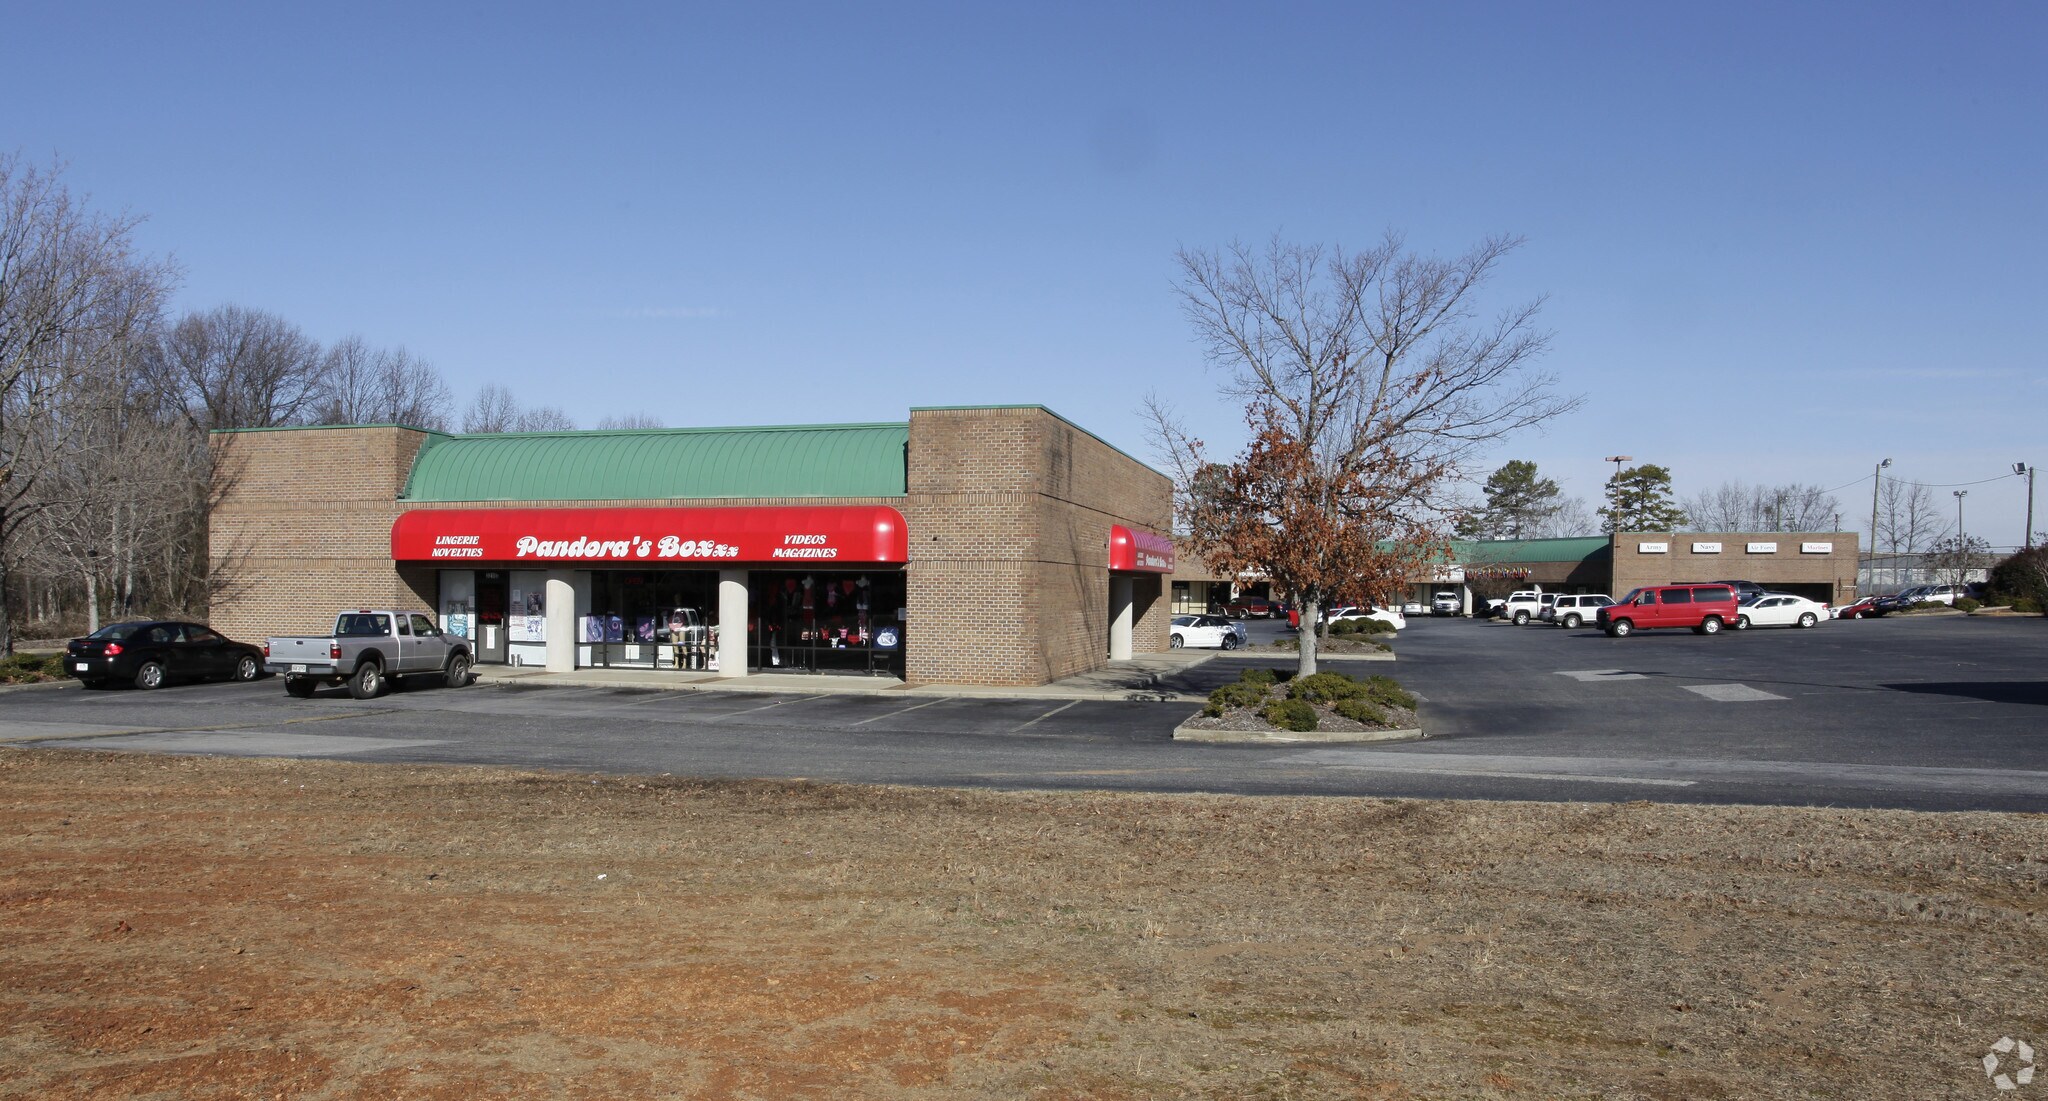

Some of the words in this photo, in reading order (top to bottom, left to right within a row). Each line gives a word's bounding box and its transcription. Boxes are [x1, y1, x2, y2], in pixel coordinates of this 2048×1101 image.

[435, 535, 480, 545] LINGERIE
[784, 534, 827, 545] VIDEOS
[516, 535, 653, 558] Pandora's
[1699, 543, 1715, 551] Navy
[431, 547, 483, 557] NOVELTIES
[772, 548, 838, 558] MAGAZINES
